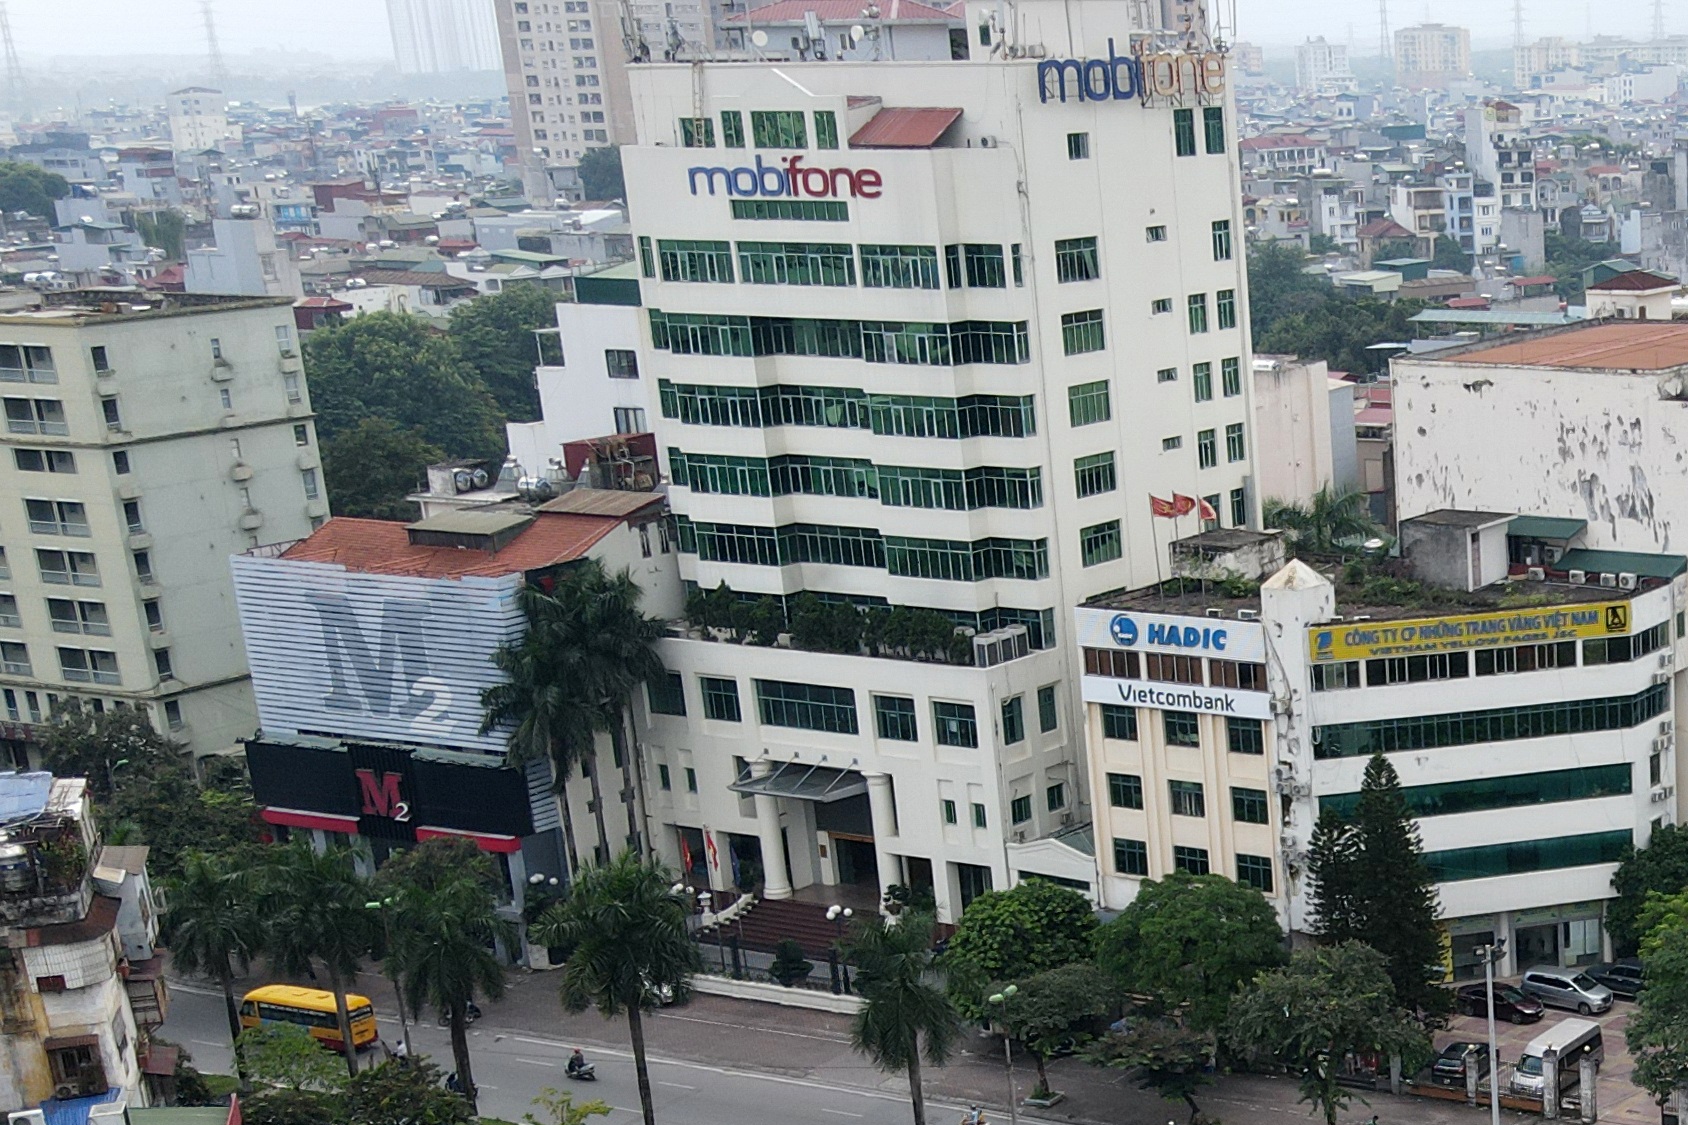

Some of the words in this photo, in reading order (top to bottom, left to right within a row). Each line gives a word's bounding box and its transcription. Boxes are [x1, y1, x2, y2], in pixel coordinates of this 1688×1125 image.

[1037, 37, 1225, 104] mobifone
[688, 154, 883, 199] mobifone
[1148, 623, 1227, 651] HADIC
[1345, 629, 1379, 647] CÔNG
[1382, 629, 1398, 643] TY
[1401, 627, 1416, 641] CP
[1420, 621, 1462, 640] NHỮNG
[1464, 618, 1508, 637] TRANG
[1508, 614, 1542, 632] VÀNG
[1542, 610, 1569, 629] VIỆT
[1572, 610, 1599, 626] NAM
[1369, 643, 1437, 656] VIETNAM
[1441, 637, 1501, 649] YELLOW
[1503, 632, 1549, 644] PAGES
[1552, 629, 1577, 639] JSC
[1117, 684, 1236, 713] Vietcombank
